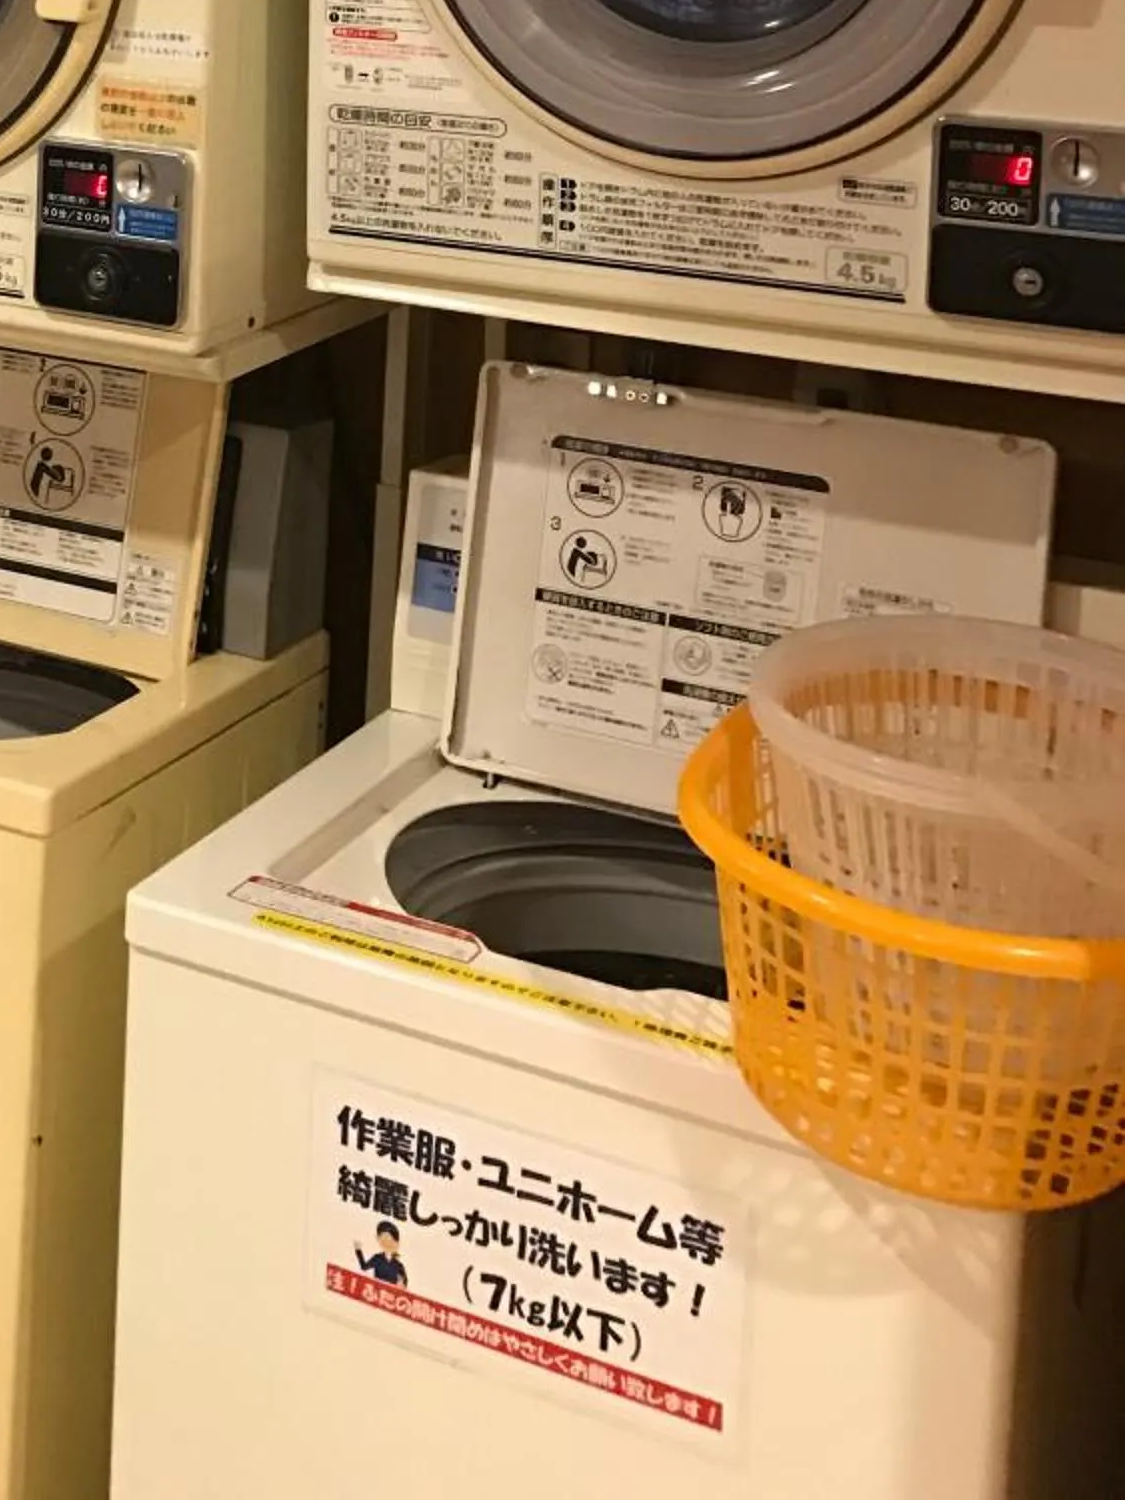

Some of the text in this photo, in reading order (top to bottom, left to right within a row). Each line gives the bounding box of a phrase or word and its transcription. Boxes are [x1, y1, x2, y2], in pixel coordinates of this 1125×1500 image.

[1015, 157, 1033, 181] 0
[987, 200, 1018, 218] 200
[836, 259, 875, 284] 4.5
[692, 475, 704, 491] 2
[550, 516, 562, 531] 3
[336, 1104, 727, 1267] 作業服・ユニホーム等
[336, 1163, 707, 1318] 綺麗しっかり洗います！
